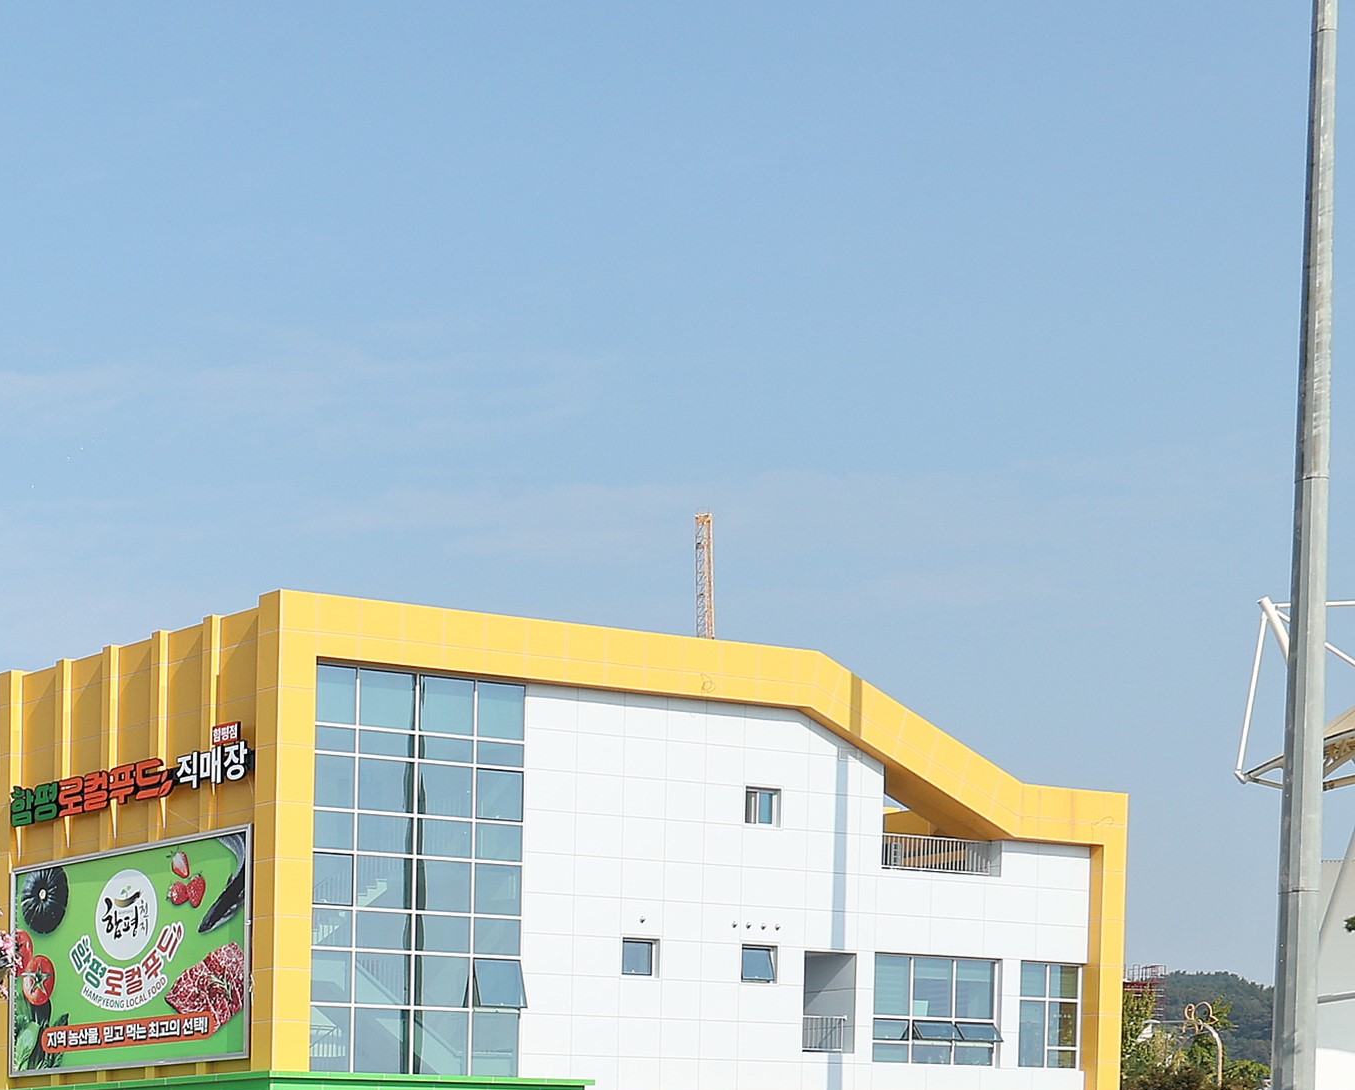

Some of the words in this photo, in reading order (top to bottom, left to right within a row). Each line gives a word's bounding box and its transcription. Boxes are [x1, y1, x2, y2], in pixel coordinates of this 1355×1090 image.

[212, 723, 239, 743] 함평점
[176, 740, 248, 789] 직매장
[102, 893, 141, 940] 함평
[83, 986, 125, 1008] HAMPYEONG
[125, 992, 148, 1008] LOCAL
[148, 976, 167, 998] FOOD
[46, 1030, 66, 1048] 지역
[103, 1025, 124, 1042] 믿고
[126, 1023, 147, 1040] 먹는
[148, 1019, 180, 1038] 최고의
[183, 1016, 208, 1035] 선택!
